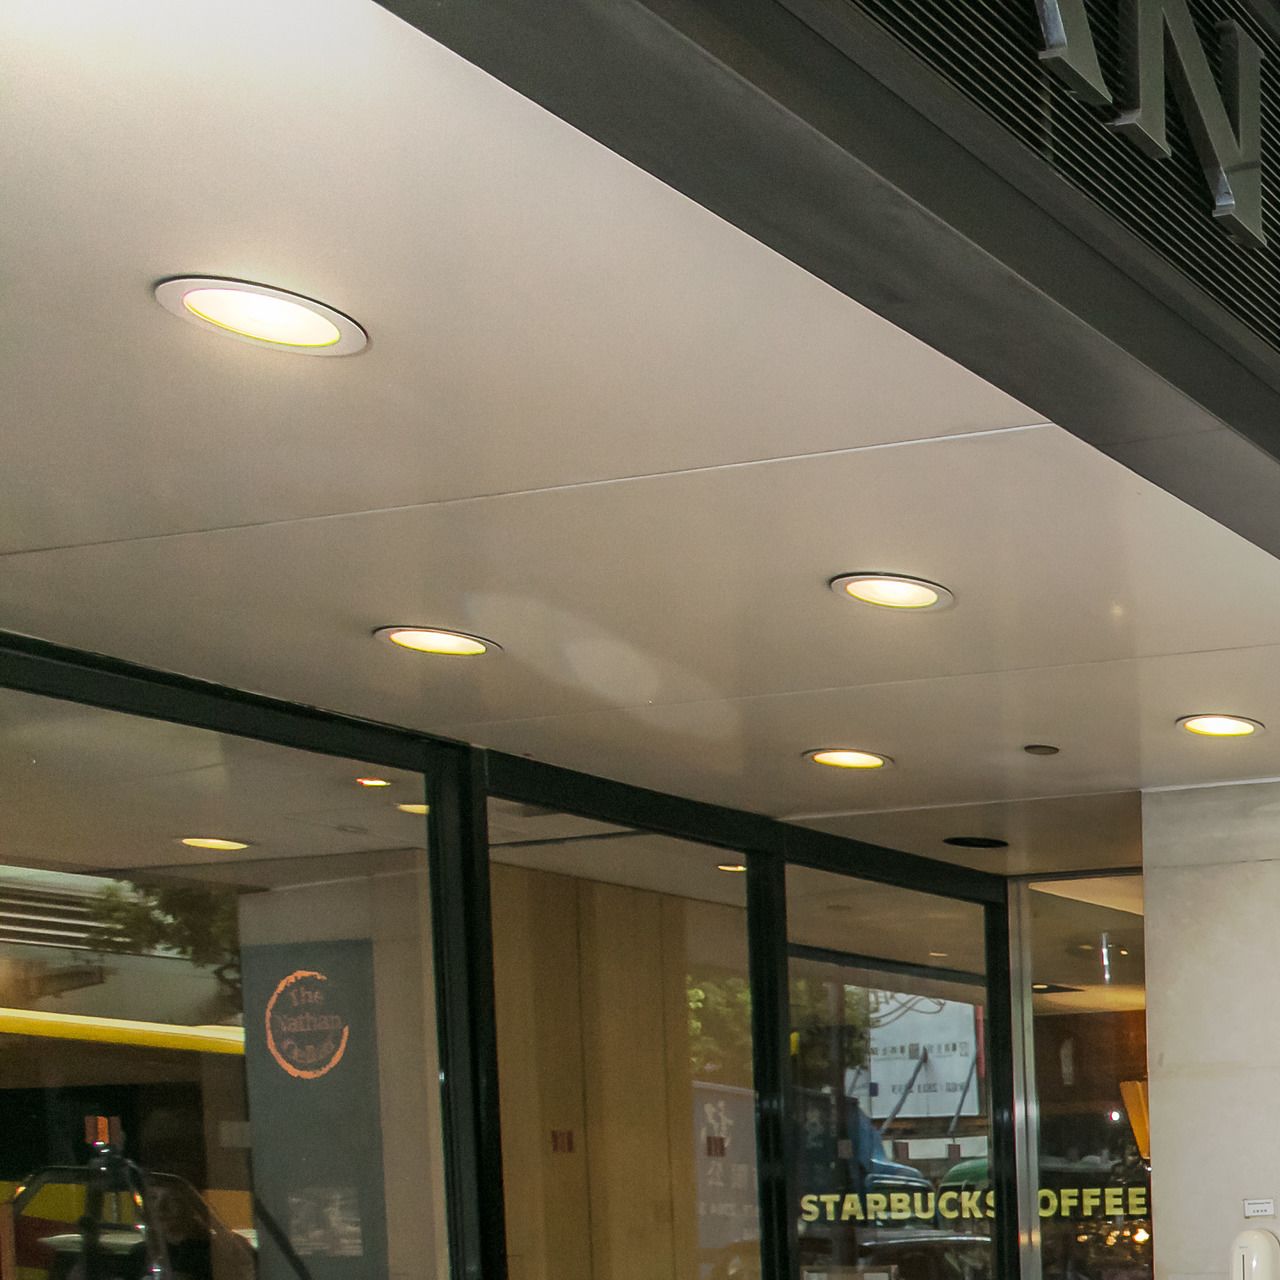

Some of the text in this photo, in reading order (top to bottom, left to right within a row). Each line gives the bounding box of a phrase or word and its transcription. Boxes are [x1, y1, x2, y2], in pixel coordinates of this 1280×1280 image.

[1038, 0, 1267, 248] N
[800, 1187, 1148, 1223] STARBUCKS OFFEE
